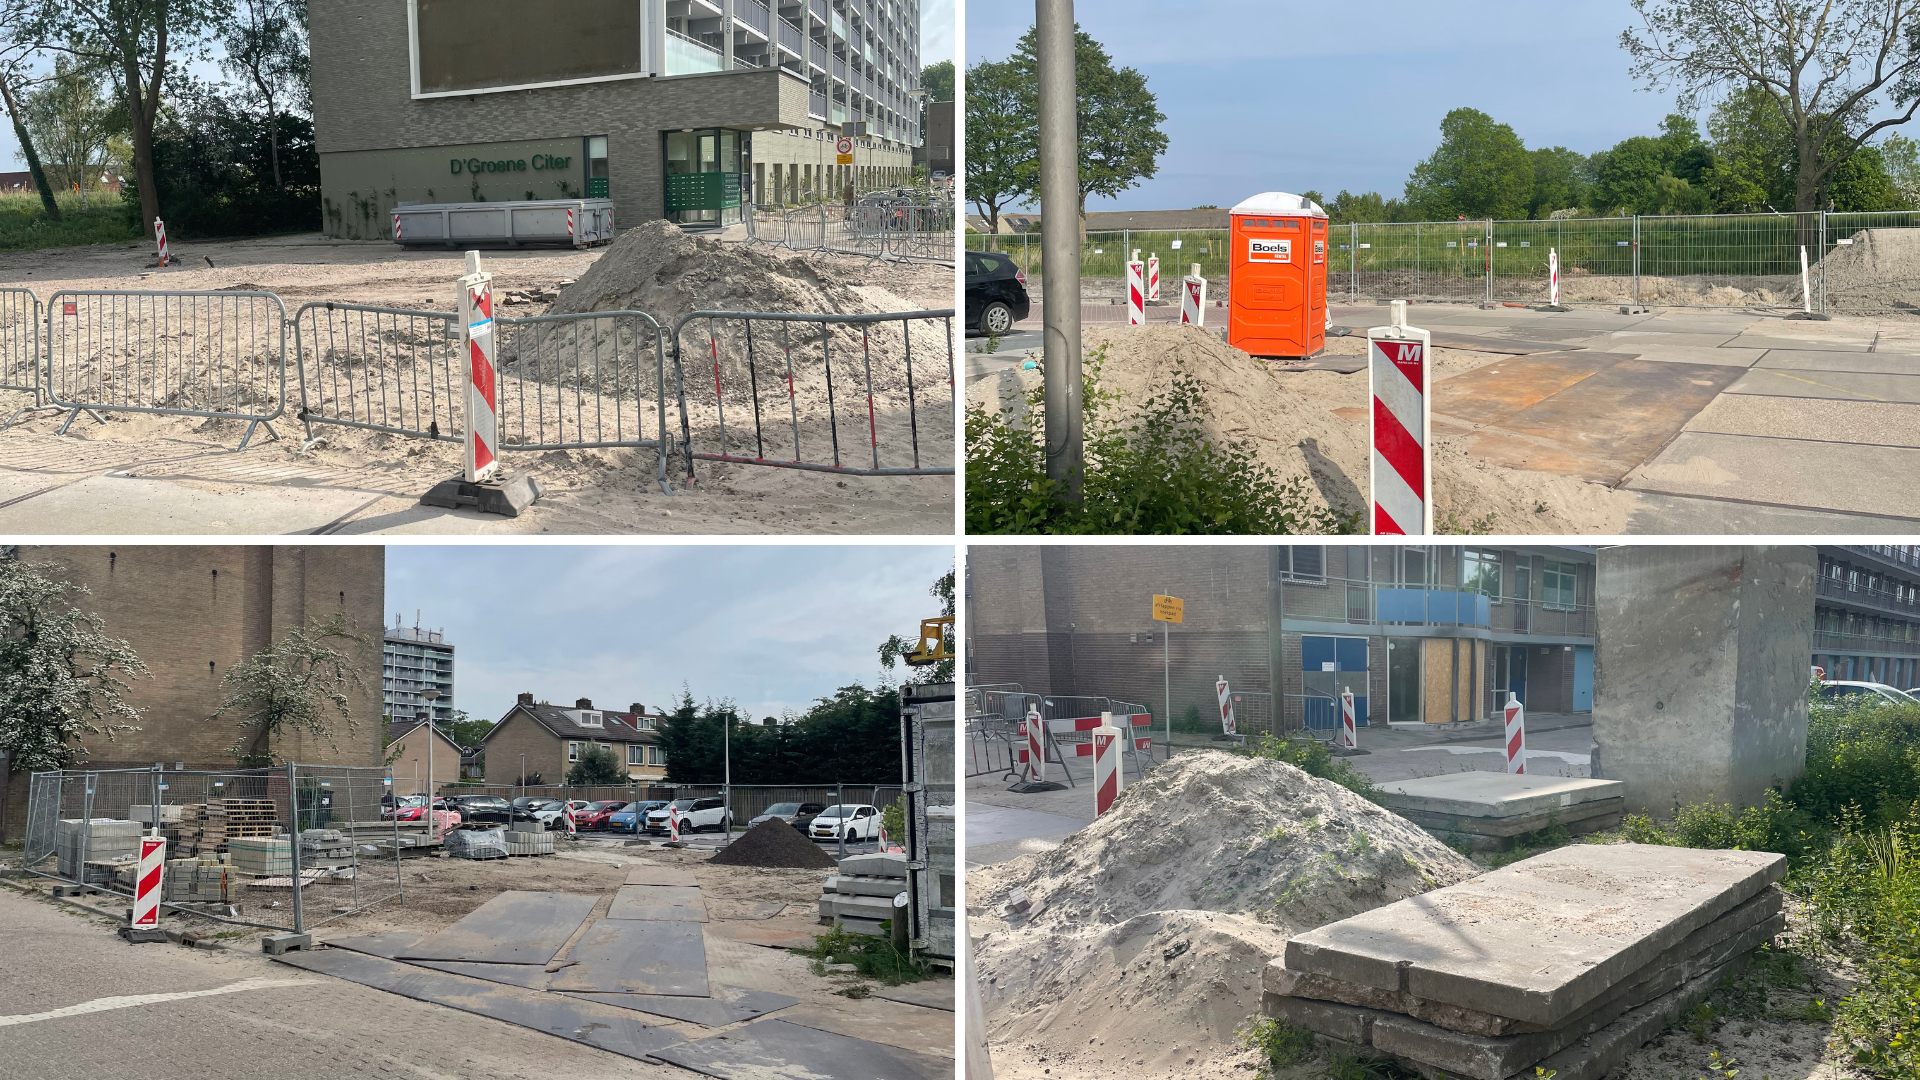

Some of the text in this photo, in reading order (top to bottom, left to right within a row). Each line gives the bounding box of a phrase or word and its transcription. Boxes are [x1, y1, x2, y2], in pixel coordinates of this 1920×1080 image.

[531, 153, 572, 171] Citer
[1252, 243, 1288, 253] Boels
[1191, 285, 1201, 295] M
[1397, 344, 1422, 362] M
[1096, 735, 1106, 746] M
